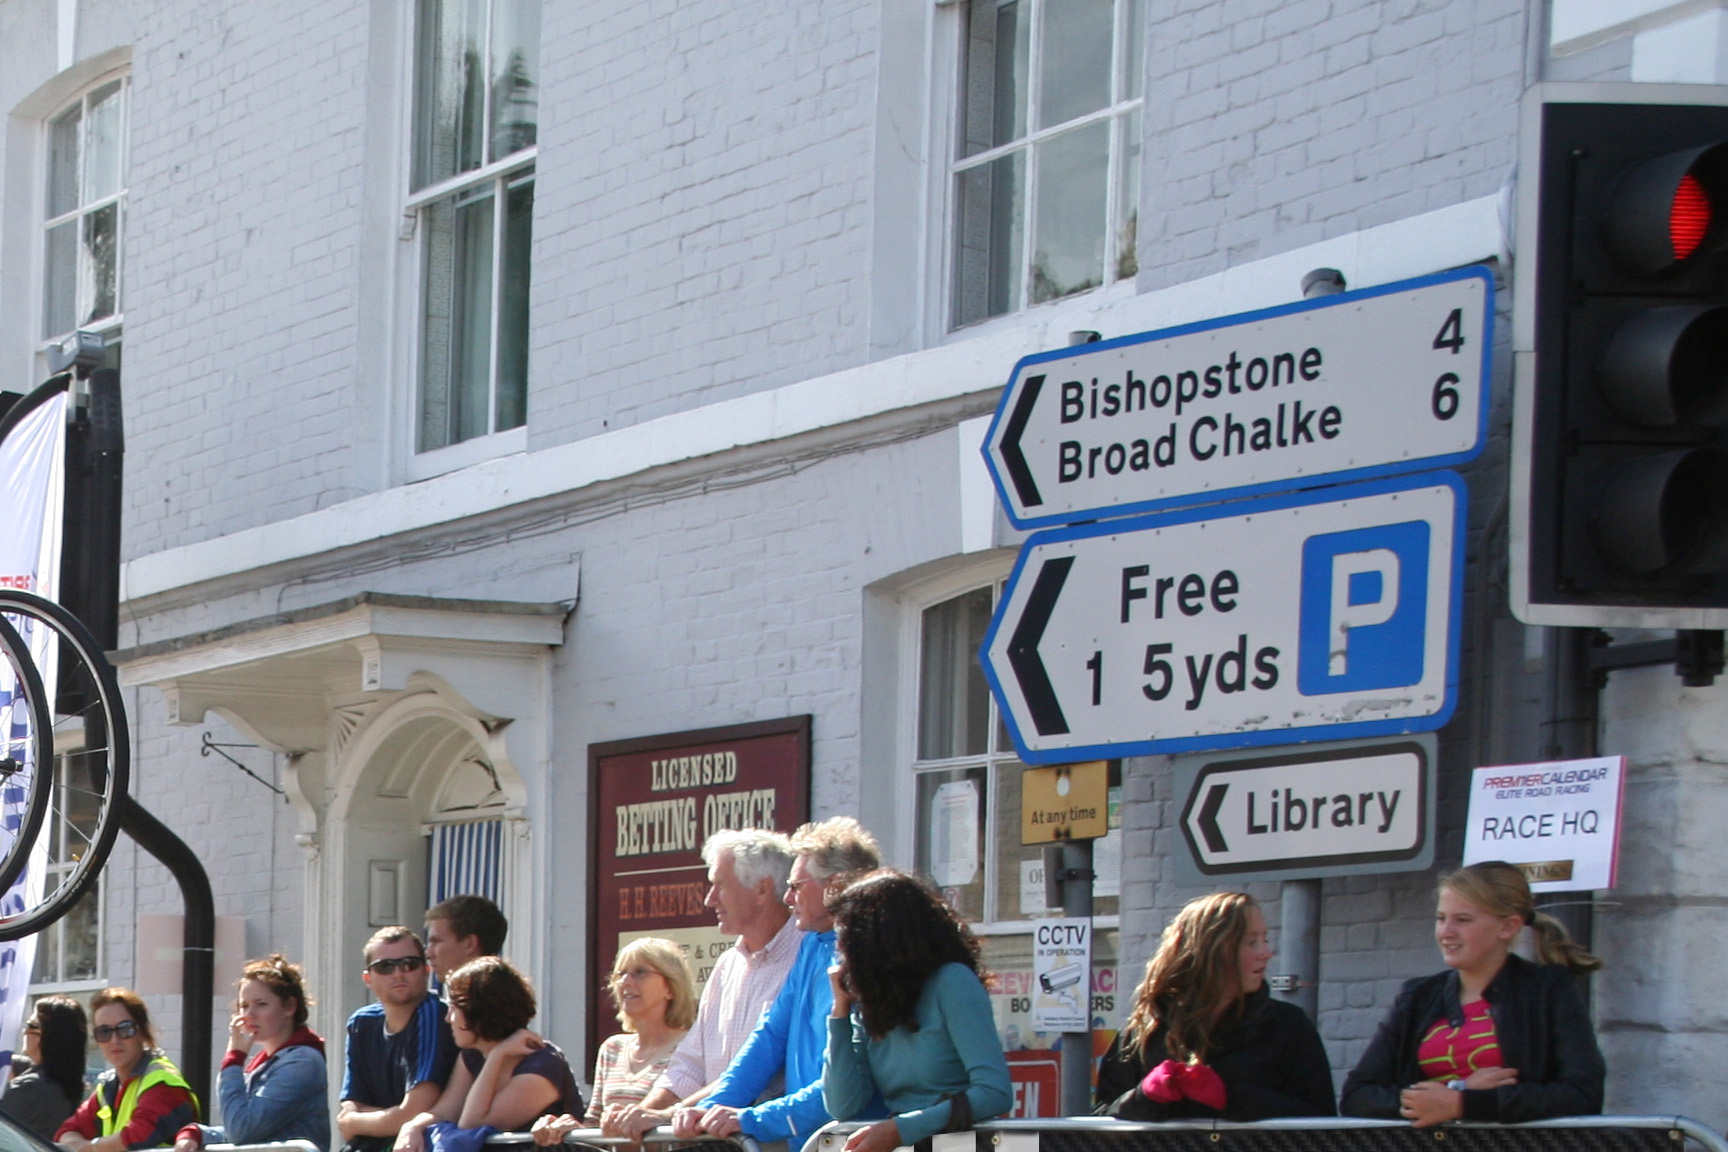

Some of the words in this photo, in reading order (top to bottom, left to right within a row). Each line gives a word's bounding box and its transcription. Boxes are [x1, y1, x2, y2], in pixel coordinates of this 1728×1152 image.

[1060, 347, 1322, 424] Bishopstone
[1432, 308, 1465, 355] 4
[1058, 422, 1177, 483] Broad
[1189, 400, 1342, 461] Chalke
[1432, 372, 1460, 421] 6
[1121, 564, 1239, 624] Free
[651, 751, 737, 791] LICENSED
[1247, 788, 1401, 834] Library
[1495, 788, 1523, 800] ELITE
[1525, 786, 1552, 798] ROAD
[1555, 783, 1591, 796] RACING
[615, 797, 697, 857] BETTING
[1031, 810, 1045, 825] At
[1046, 811, 1068, 824] any
[1069, 806, 1097, 821] time
[1482, 813, 1555, 841] RACE
[1561, 810, 1599, 836] HQ
[649, 881, 704, 919] REEVES
[1038, 925, 1087, 945] CCTV
[1046, 948, 1086, 957] OPERATION
